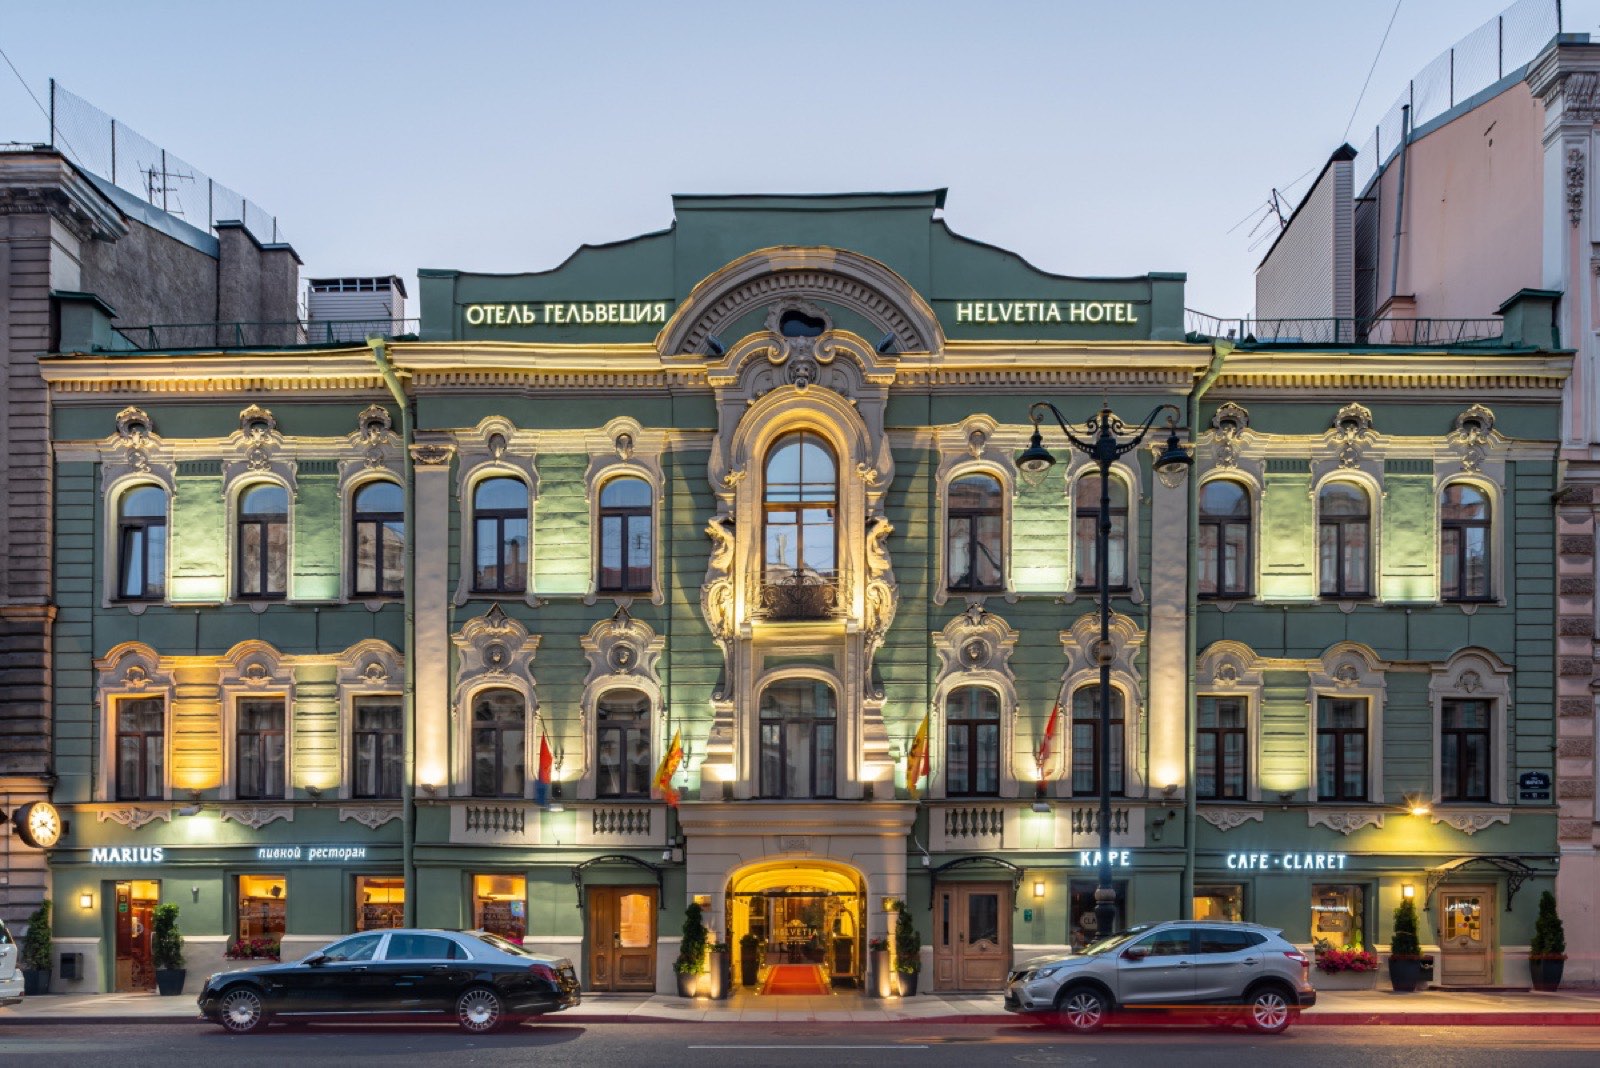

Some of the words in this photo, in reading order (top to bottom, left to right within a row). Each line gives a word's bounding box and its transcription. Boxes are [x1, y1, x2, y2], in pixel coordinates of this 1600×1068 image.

[466, 304, 536, 325] ОТЕЛЬ
[544, 303, 666, 323] ГЕЛЬВЕЦИЯ
[956, 303, 1061, 322] HELVETIA
[1070, 303, 1138, 322] HOTEL
[91, 847, 164, 862] MARIUS
[258, 846, 301, 858] пивной
[308, 847, 366, 861] ресторан
[1226, 854, 1269, 869] CAFE
[1283, 854, 1346, 869] CLARET
